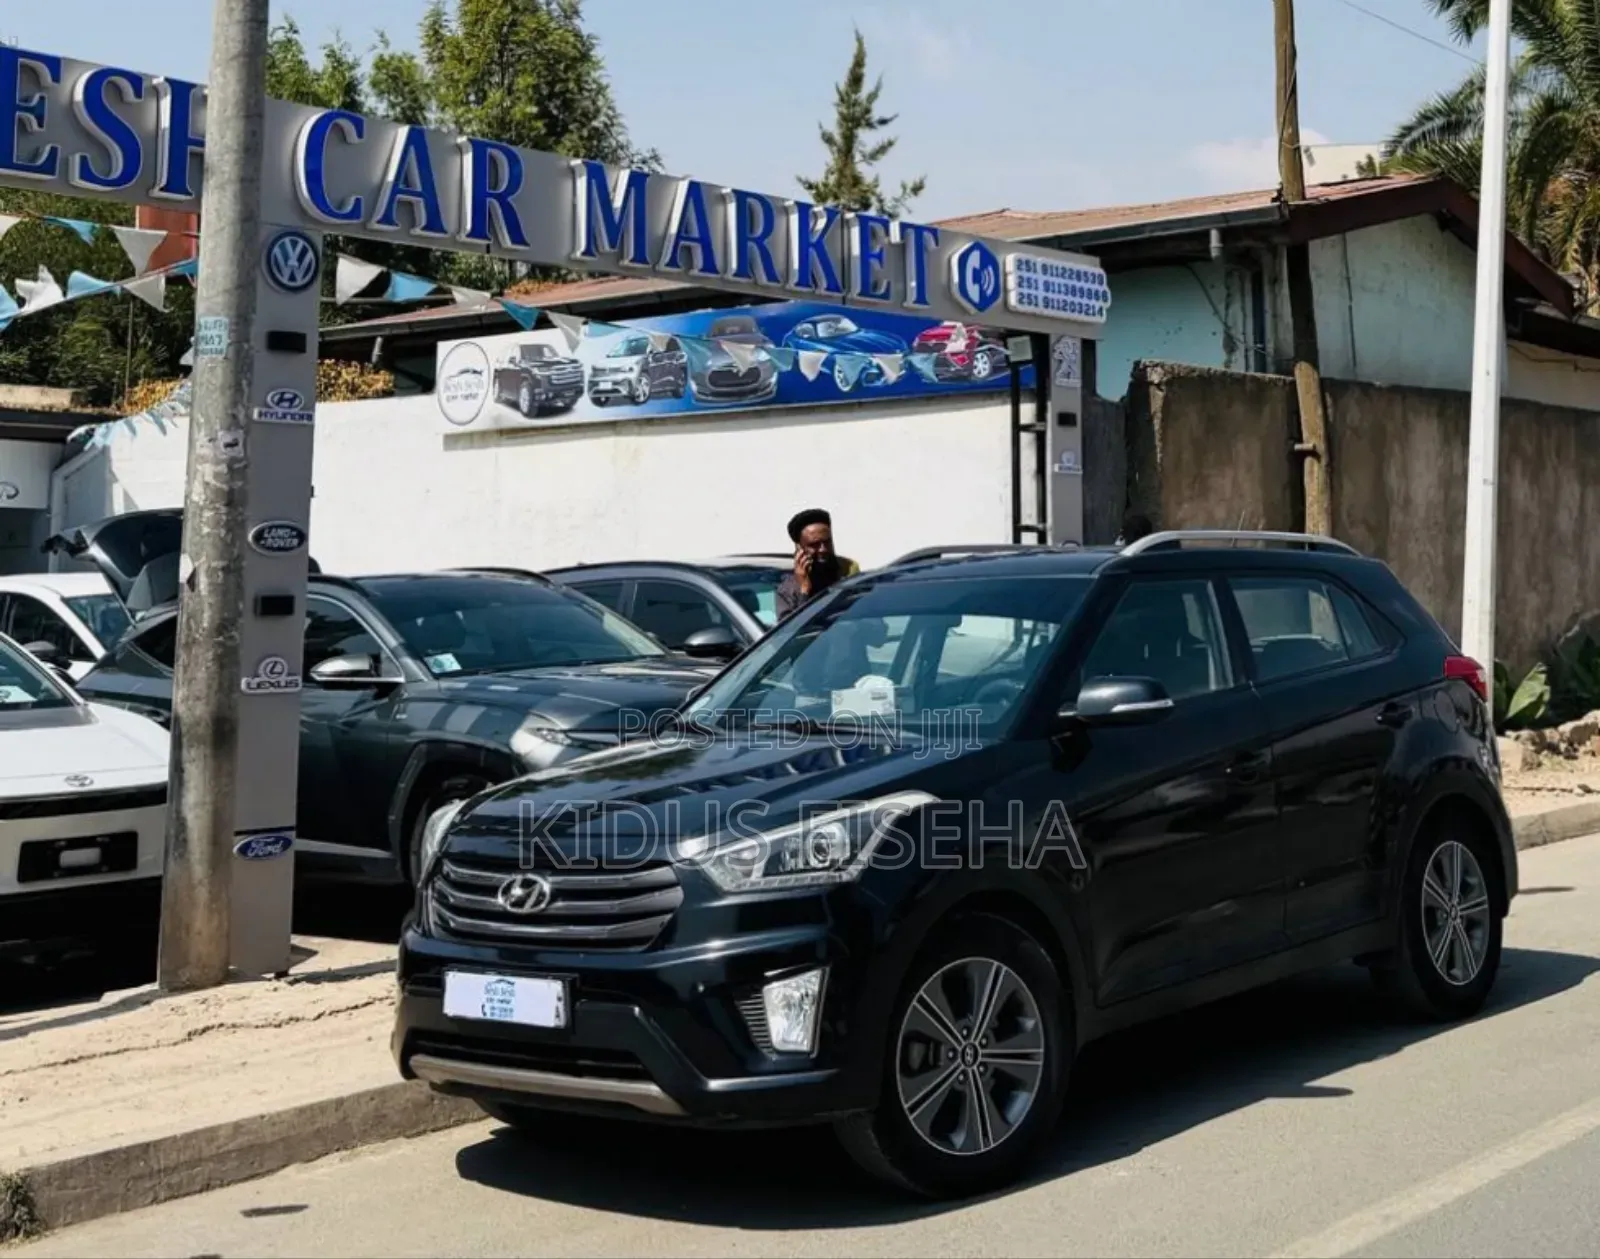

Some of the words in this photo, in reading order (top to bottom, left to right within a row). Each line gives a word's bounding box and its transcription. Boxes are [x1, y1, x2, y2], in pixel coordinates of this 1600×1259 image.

[297, 109, 531, 249] CAR
[571, 159, 939, 307] MARKET
[1016, 258, 1038, 273] 251
[1017, 275, 1040, 290] 251
[1018, 292, 1040, 307] 251
[246, 679, 300, 690] LEXUS
[247, 838, 284, 857] Ford
